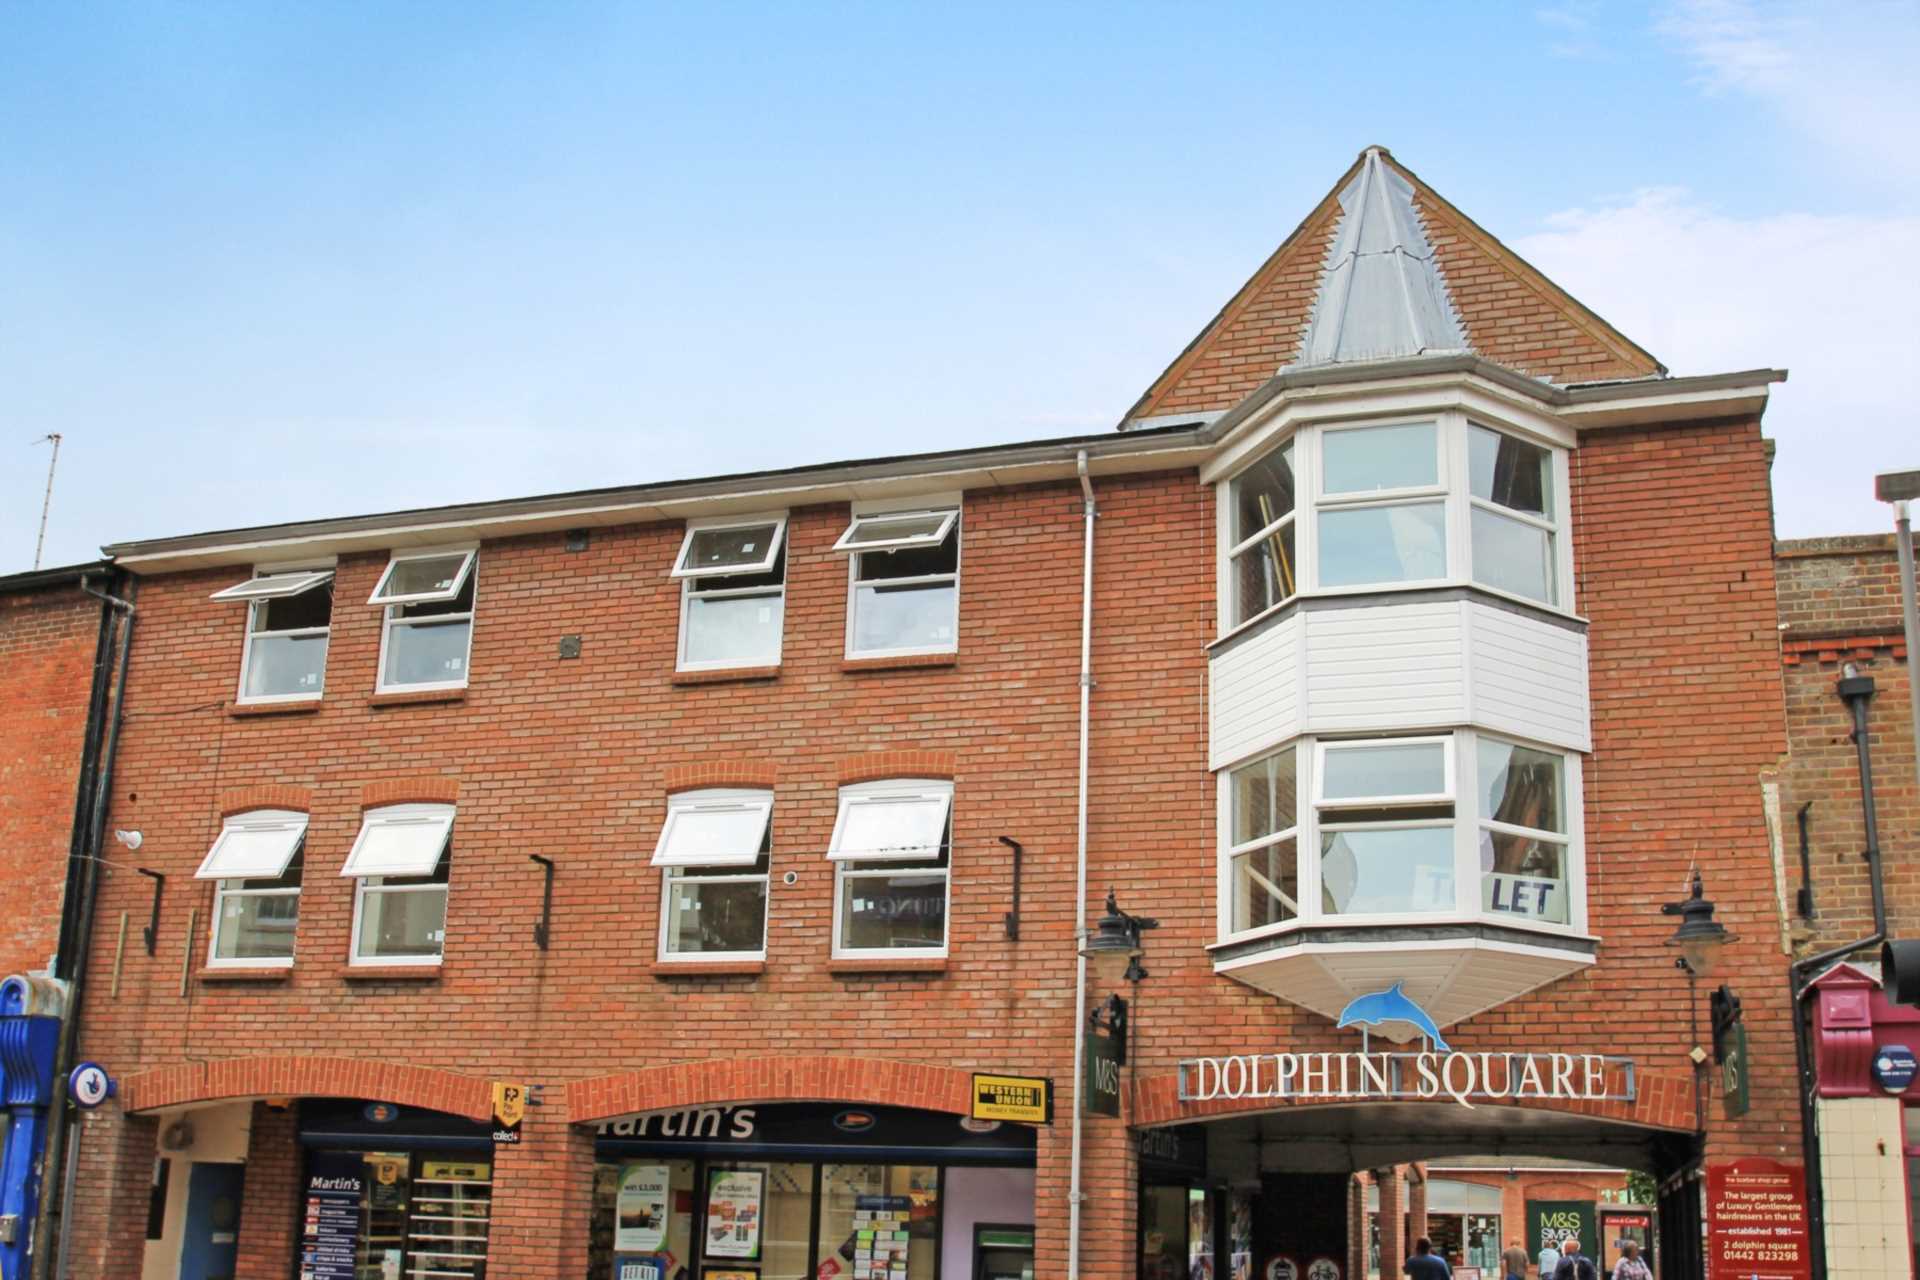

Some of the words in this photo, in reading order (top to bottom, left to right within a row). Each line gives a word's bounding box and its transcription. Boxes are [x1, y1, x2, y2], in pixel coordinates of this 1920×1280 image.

[1491, 878, 1555, 915] LET
[1095, 1056, 1118, 1095] M&S
[1196, 1052, 1392, 1101] DOLPHIN
[1416, 1051, 1608, 1110] SQUARE
[979, 1085, 1032, 1097] WESTERN
[995, 1095, 1032, 1106] UNION
[310, 1177, 361, 1191] Martin's
[1725, 1192, 1739, 1200] The
[1741, 1192, 1767, 1202] largest
[1769, 1193, 1793, 1202] group
[1716, 1202, 1725, 1210] of
[1727, 1202, 1752, 1211] Luxury
[1755, 1203, 1802, 1211] Gentlemens
[1540, 1212, 1581, 1228] M&S
[1716, 1212, 1762, 1221] hairdressers
[1765, 1213, 1773, 1221] in
[1774, 1213, 1788, 1221] the
[1728, 1227, 1772, 1235] established
[1724, 1241, 1729, 1249] 2
[1732, 1241, 1766, 1250] dolphin
[1768, 1242, 1798, 1251] square
[1723, 1251, 1754, 1260] 01442
[1758, 1251, 1799, 1261] 823298
